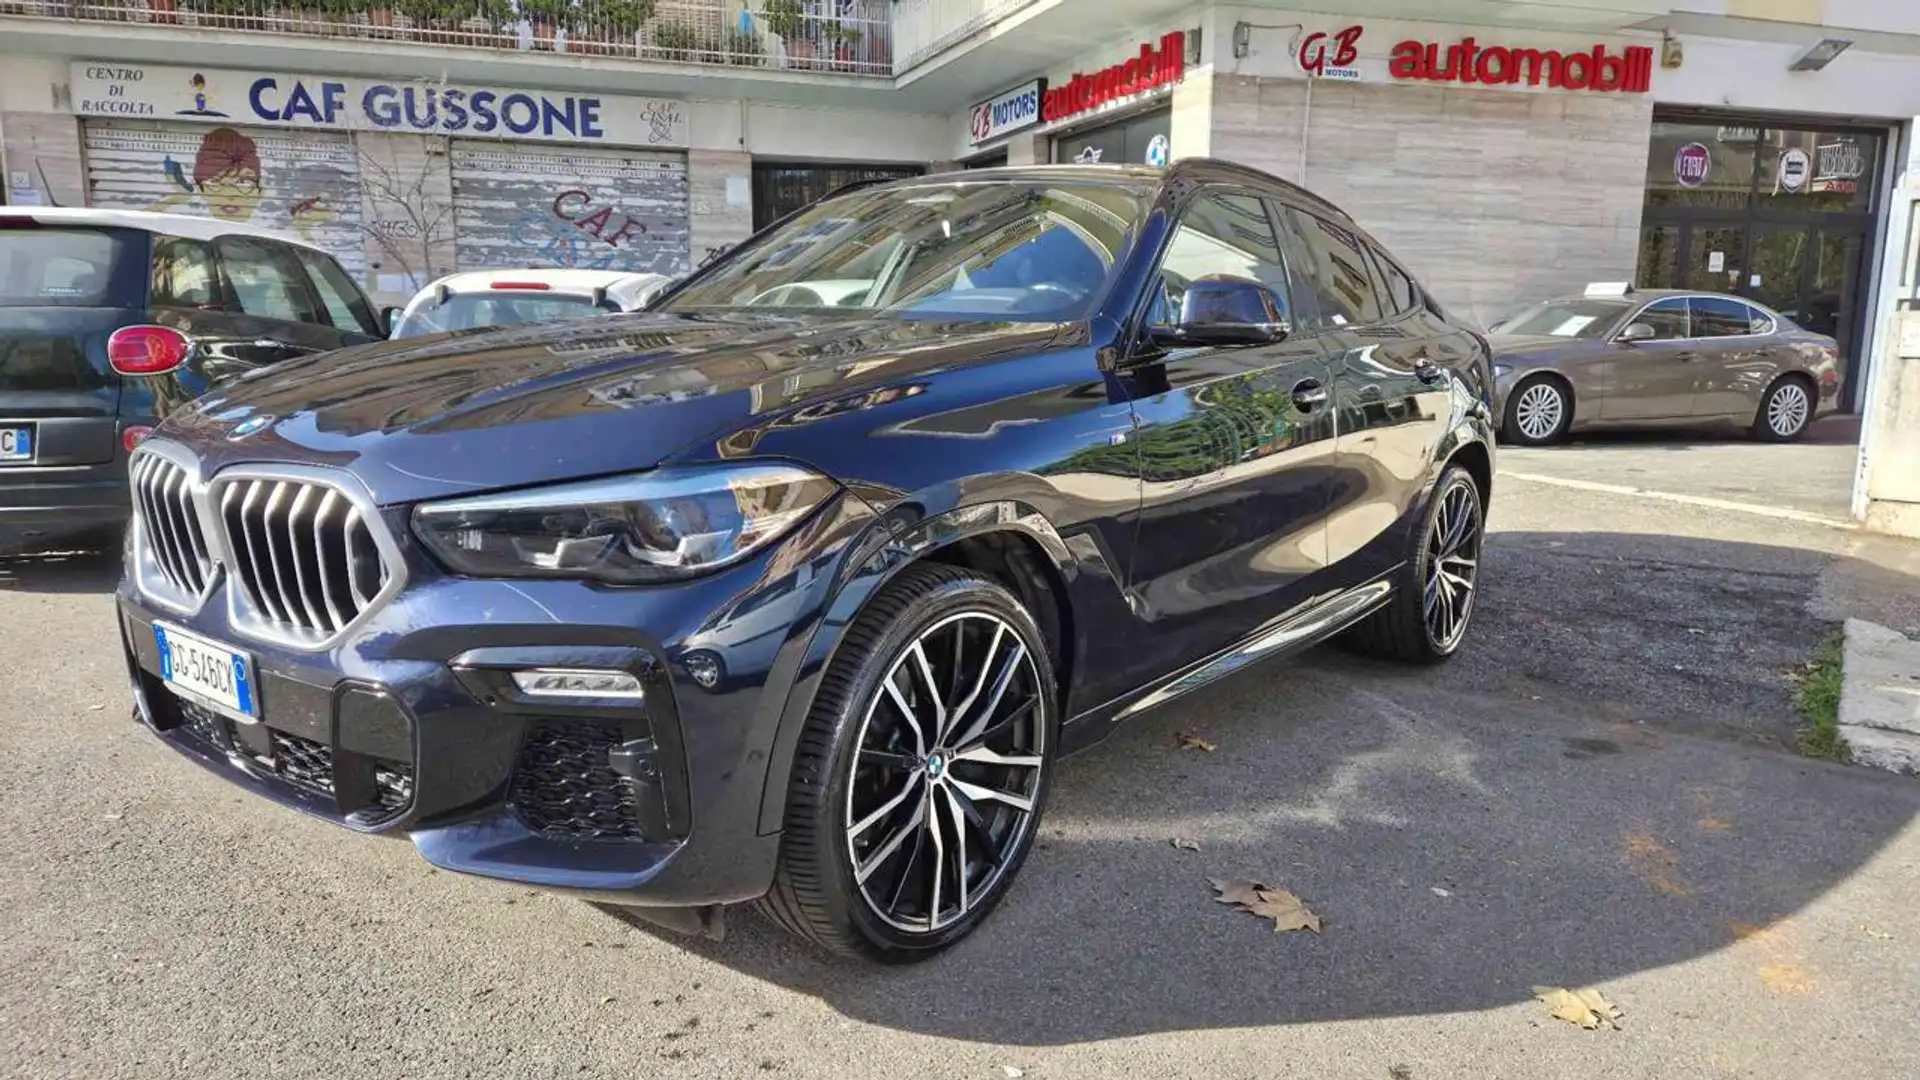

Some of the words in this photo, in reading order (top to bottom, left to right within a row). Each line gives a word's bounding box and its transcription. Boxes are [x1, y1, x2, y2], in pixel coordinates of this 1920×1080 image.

[86, 66, 144, 81] CENTRO
[1325, 68, 1359, 78] MOTORS
[109, 85, 124, 97] DI
[82, 100, 154, 115] RACCOLTA
[249, 78, 346, 123] CAF
[362, 85, 603, 138] GUSSONE
[993, 90, 1036, 128] MOTORS
[1682, 156, 1704, 177] FIAT
[553, 190, 648, 247] CAF
